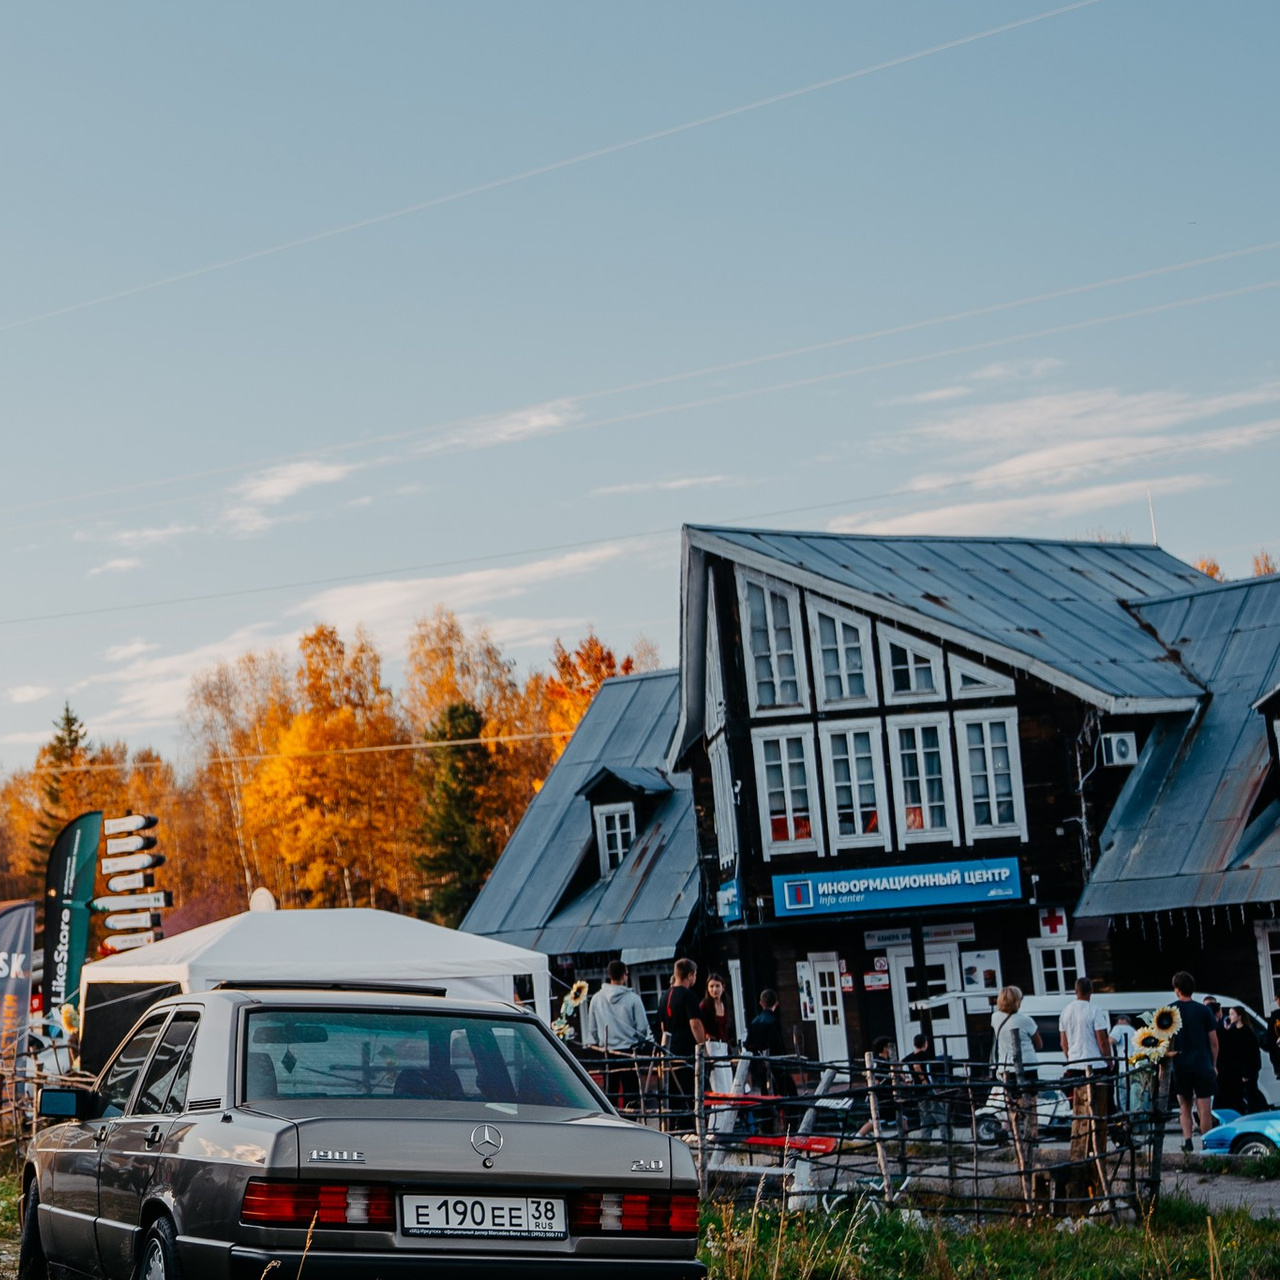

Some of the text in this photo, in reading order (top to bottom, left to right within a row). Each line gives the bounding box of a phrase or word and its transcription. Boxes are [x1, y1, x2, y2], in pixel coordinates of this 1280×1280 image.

[818, 869, 961, 895] ИНФОРМАЦИОННЫЙ
[964, 868, 1011, 885] ЦЕНТР
[838, 894, 865, 904] center
[52, 907, 71, 1004] LikeStore
[631, 1160, 663, 1169] 2.0
[531, 1200, 555, 1220] 38
[535, 1222, 553, 1230] RUS
